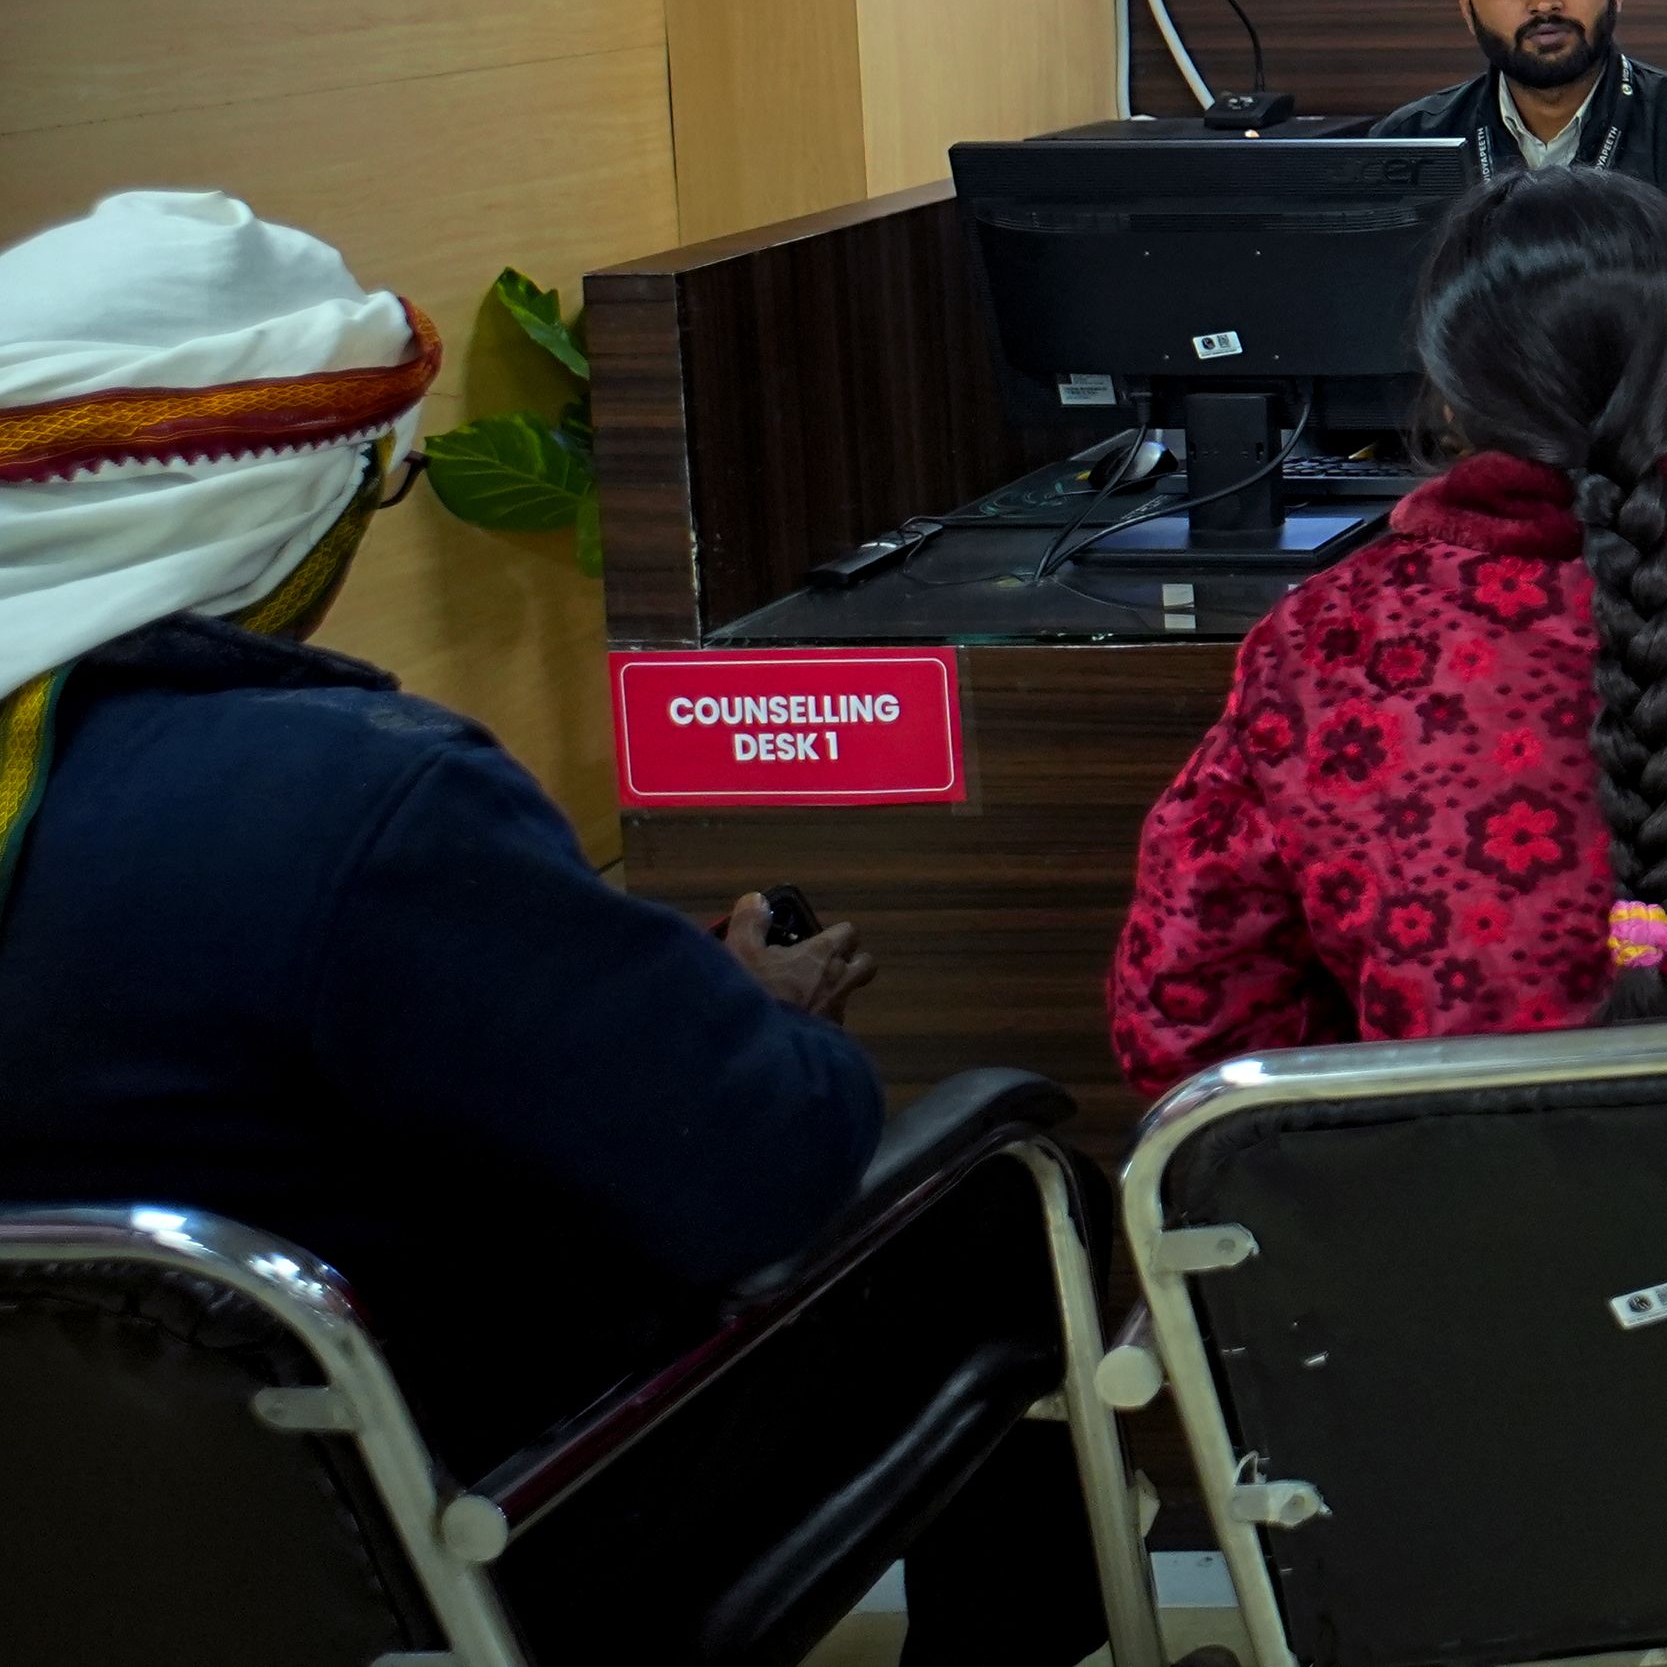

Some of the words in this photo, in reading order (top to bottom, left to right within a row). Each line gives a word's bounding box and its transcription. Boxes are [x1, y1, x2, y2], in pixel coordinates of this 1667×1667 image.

[670, 694, 900, 725] COUNSELLING
[734, 732, 820, 761] DESK
[826, 732, 839, 760] 1
